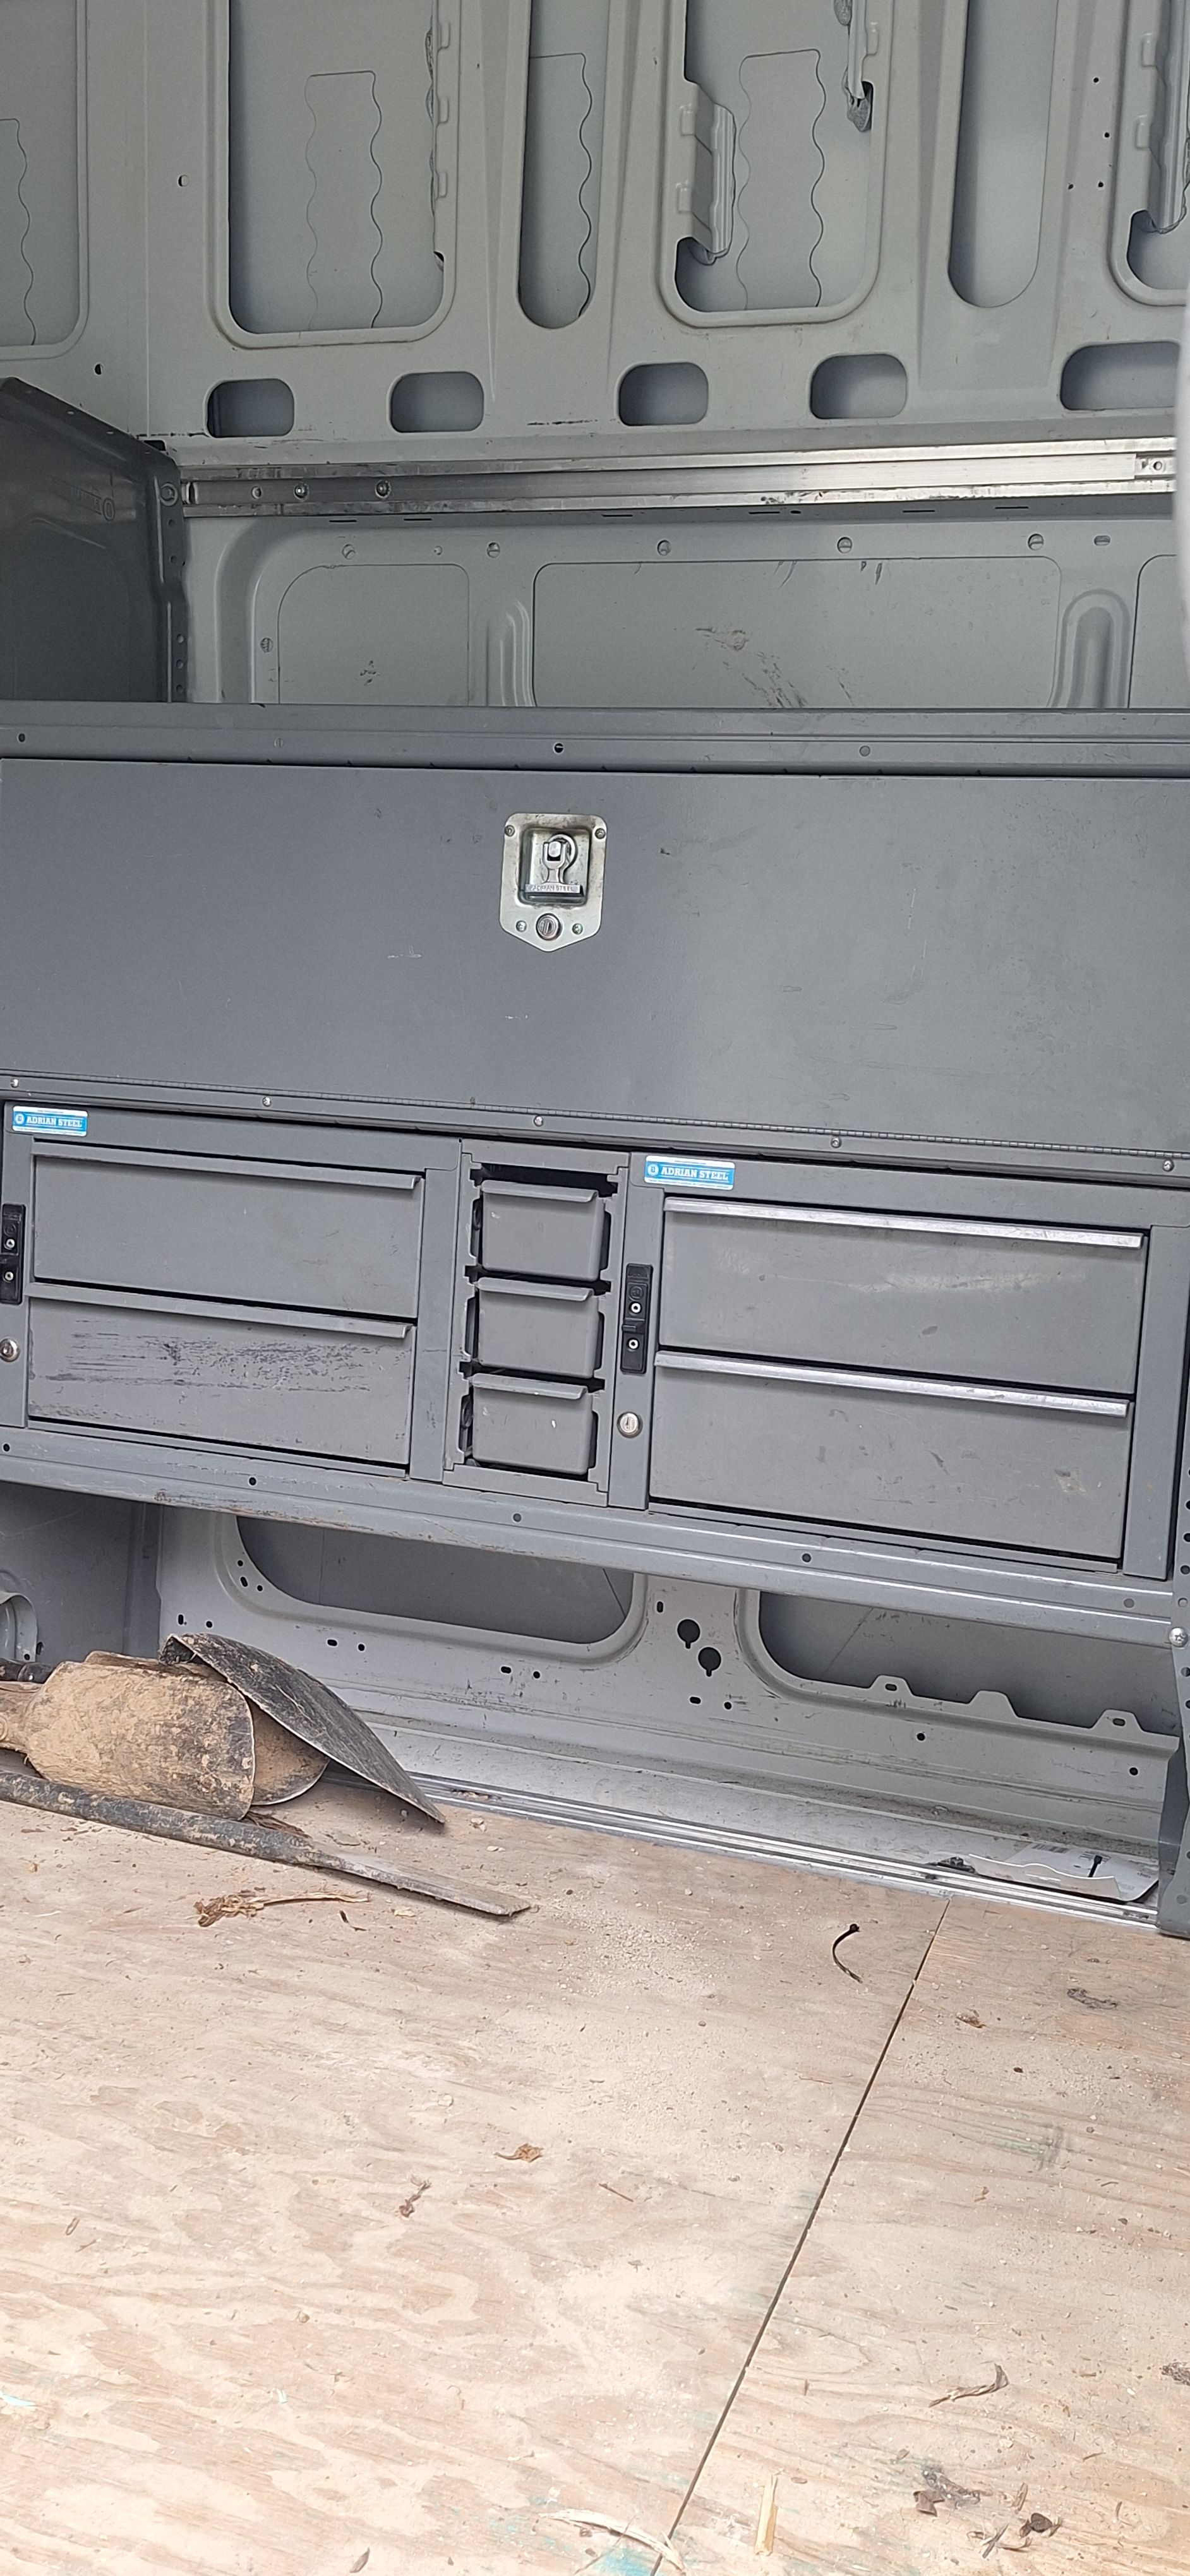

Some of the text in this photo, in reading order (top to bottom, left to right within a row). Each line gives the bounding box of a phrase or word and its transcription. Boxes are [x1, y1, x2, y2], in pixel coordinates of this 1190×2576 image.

[27, 1116, 82, 1128] ADRIAN STEEL
[661, 1166, 729, 1180] ADRIAN STEEL
